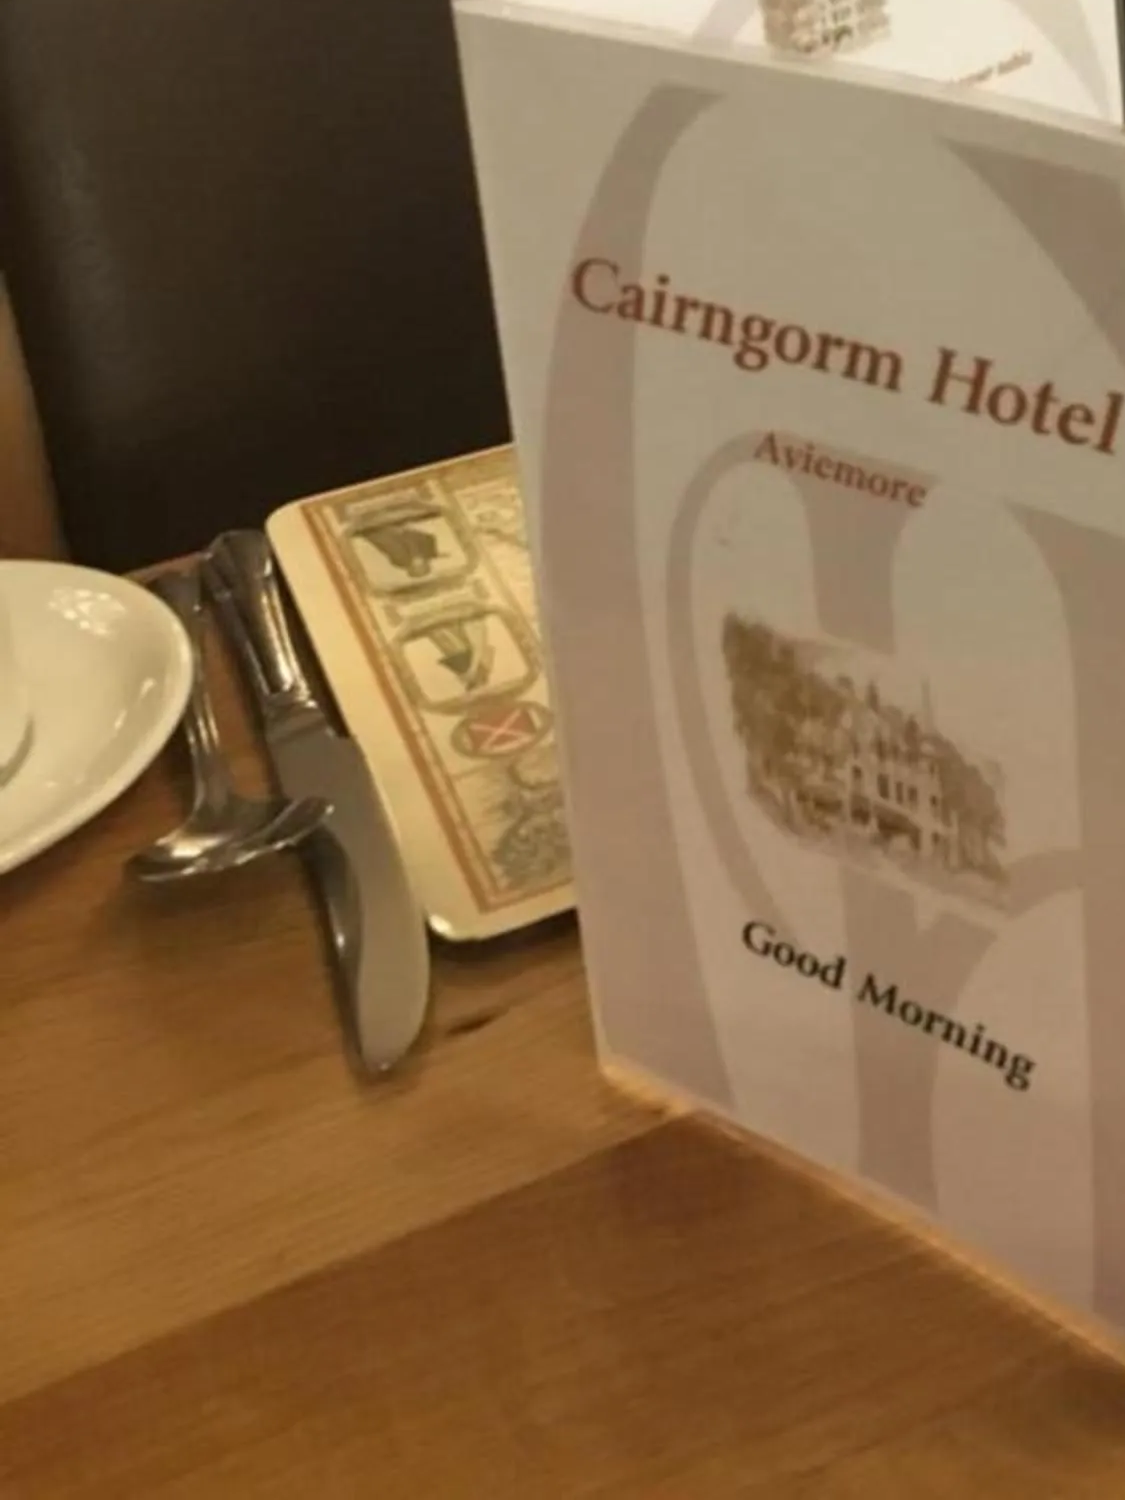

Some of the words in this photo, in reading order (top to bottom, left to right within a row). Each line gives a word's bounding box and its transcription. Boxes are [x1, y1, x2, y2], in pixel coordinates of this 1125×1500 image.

[569, 256, 904, 392] Cairngorm
[926, 346, 1125, 455] Hotel
[752, 430, 927, 508] Aviemore
[741, 920, 847, 990] Good
[856, 972, 1036, 1092] Morning
